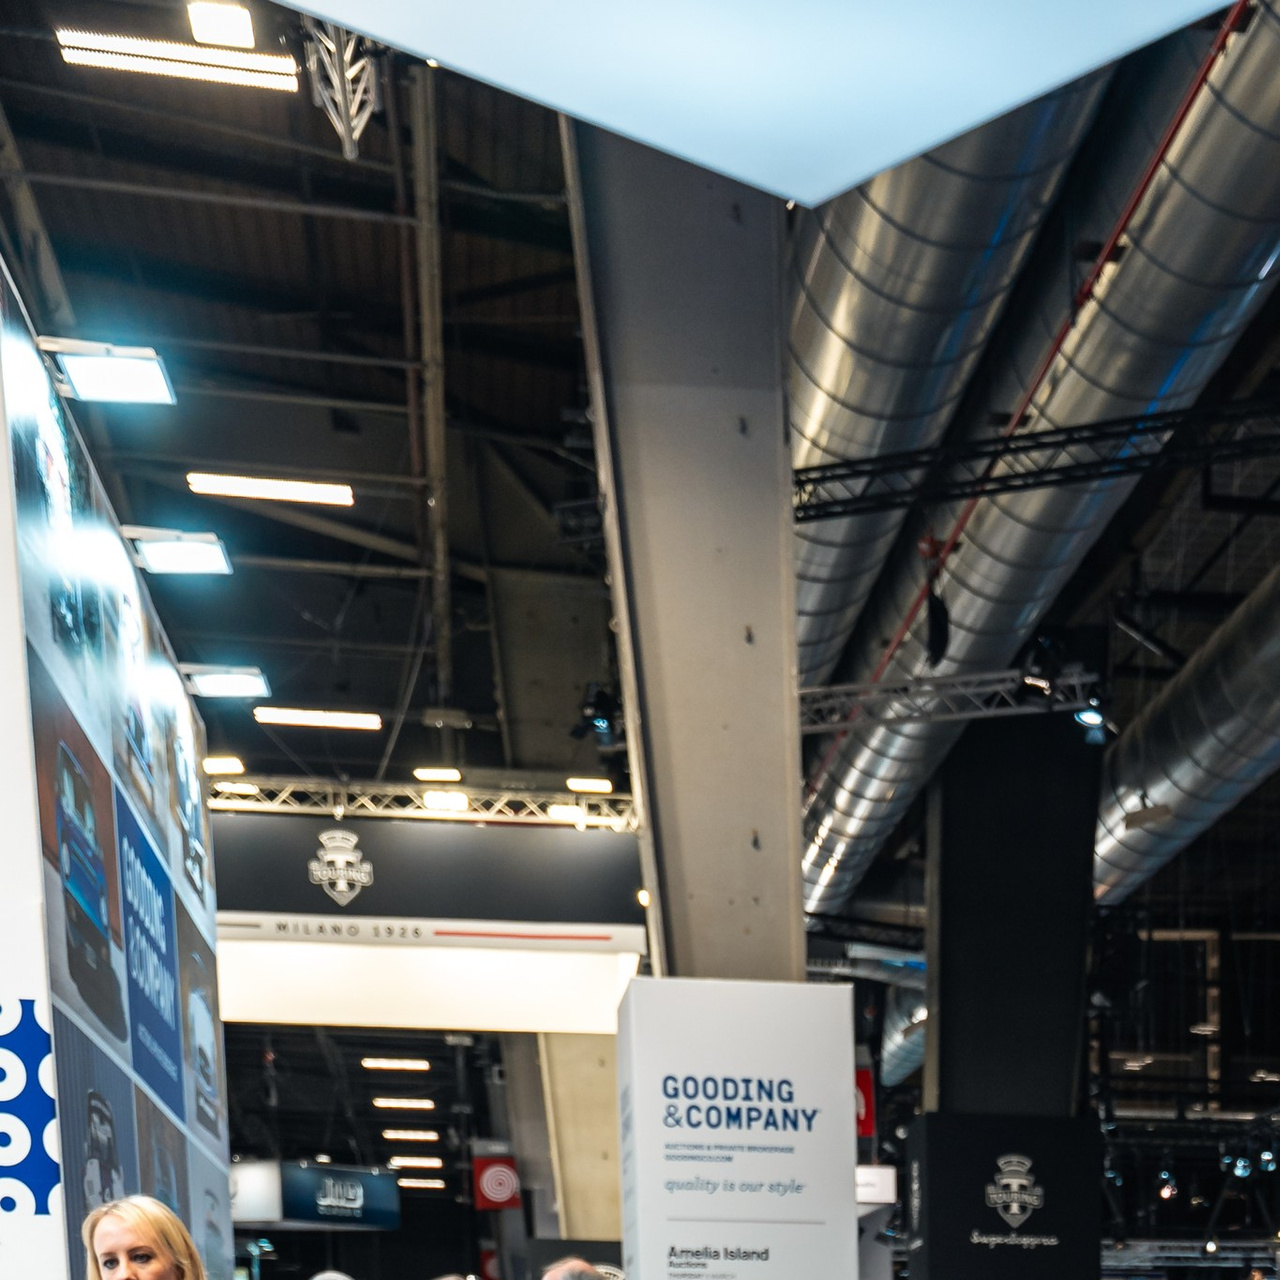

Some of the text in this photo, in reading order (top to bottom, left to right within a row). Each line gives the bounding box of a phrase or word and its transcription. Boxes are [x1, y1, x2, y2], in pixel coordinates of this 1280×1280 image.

[276, 922, 423, 938] MILANO 1926
[662, 1075, 794, 1103] GOODING
[662, 1103, 818, 1132] &COMPANY
[663, 1177, 805, 1197] quality is our style
[668, 1245, 770, 1261] Amelia Island
